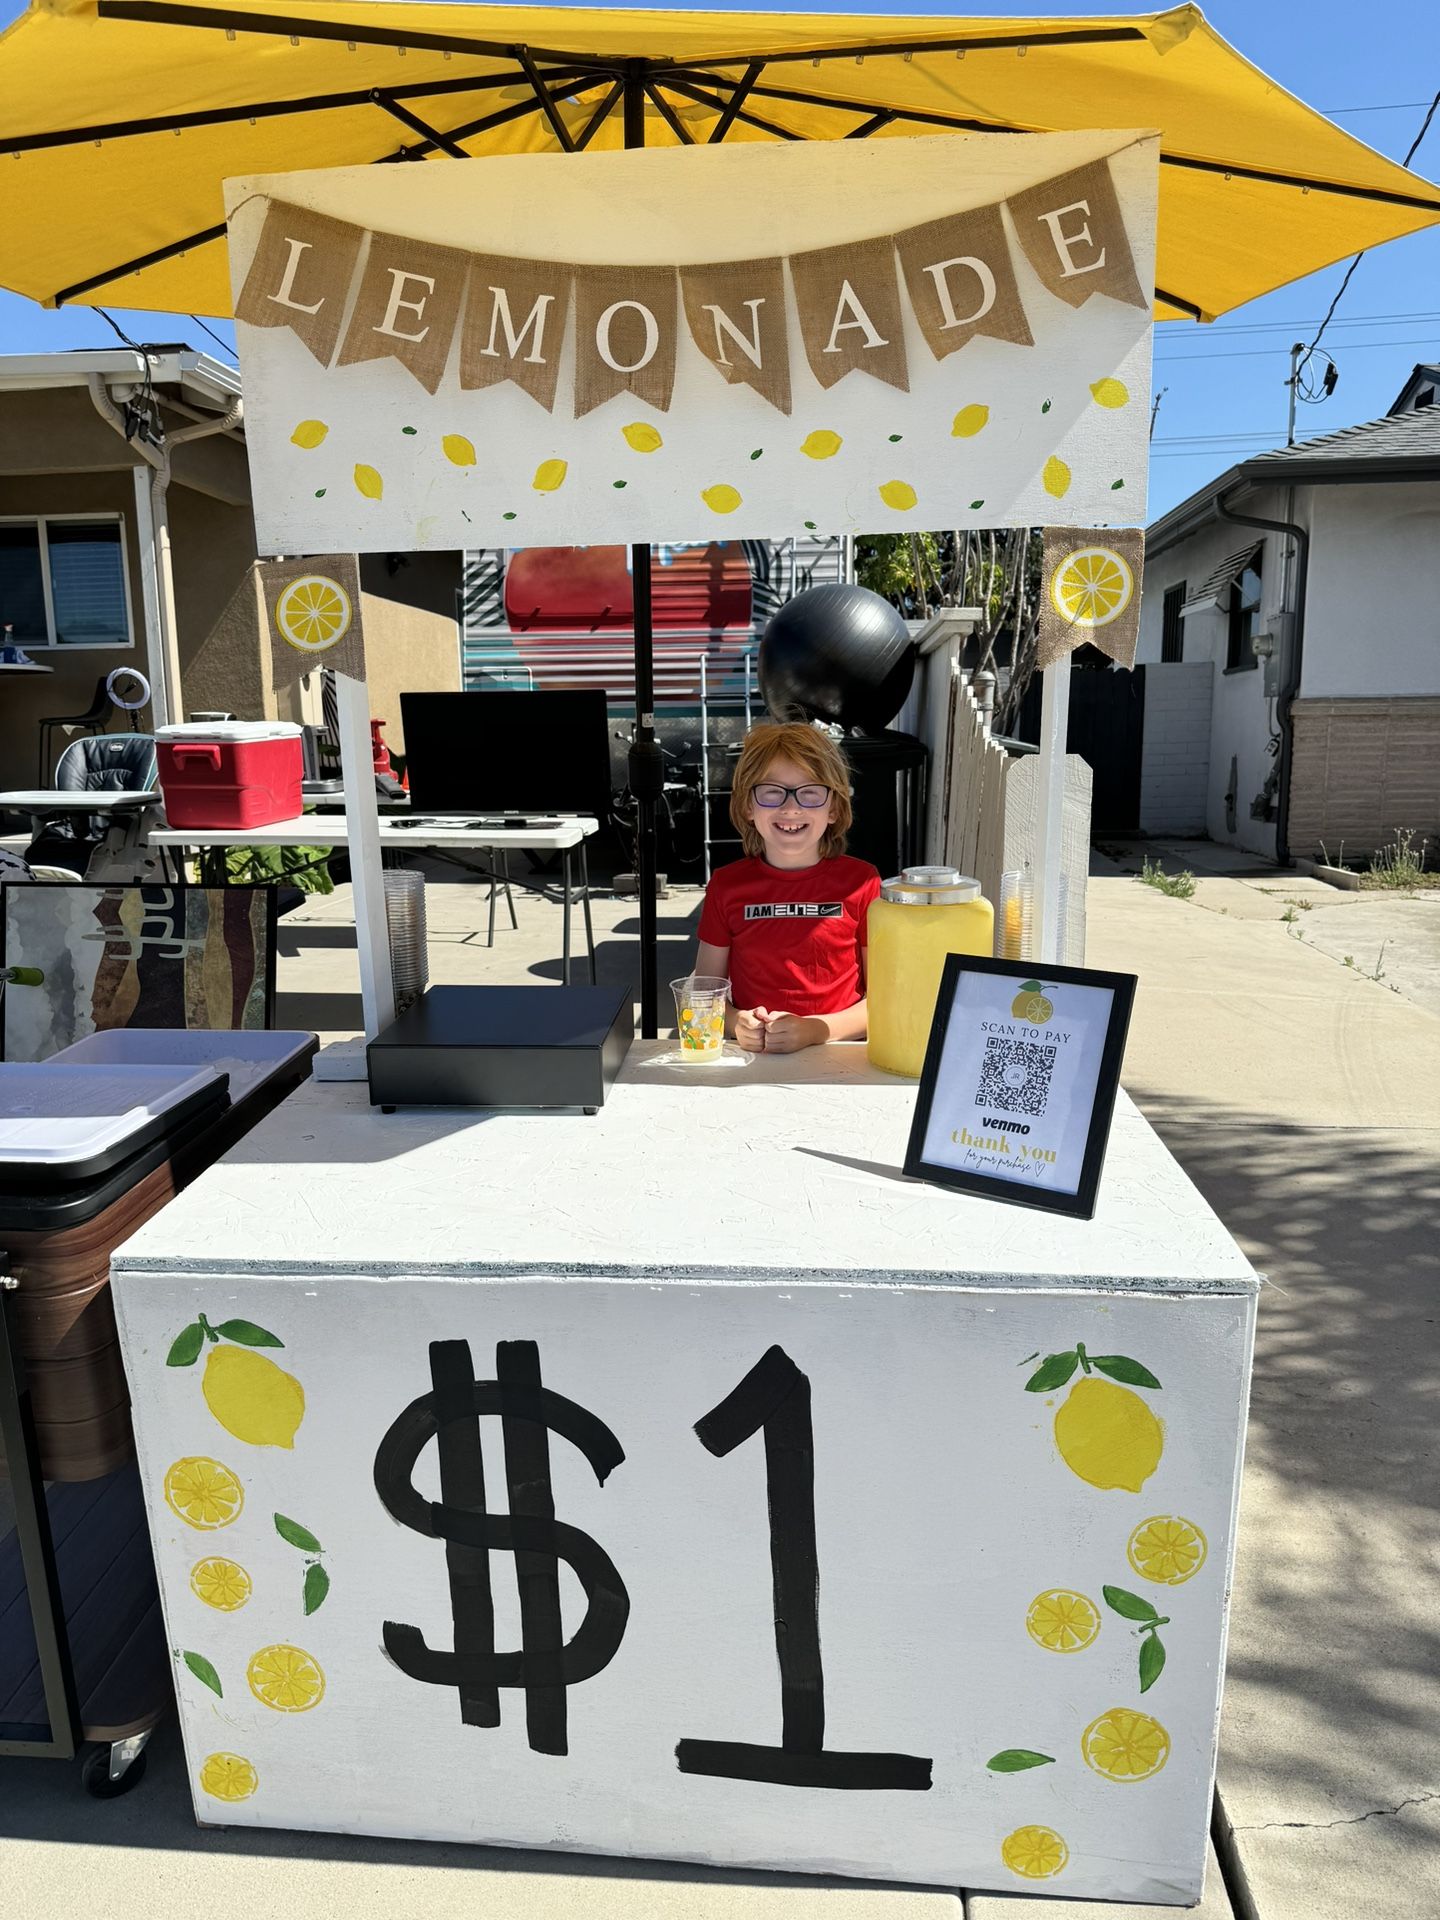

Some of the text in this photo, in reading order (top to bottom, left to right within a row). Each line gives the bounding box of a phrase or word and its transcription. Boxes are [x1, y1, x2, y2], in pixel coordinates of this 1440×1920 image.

[267, 200, 1106, 372] LEMONADE
[746, 904, 819, 918] I AM ELITE
[980, 1021, 1071, 1044] SCAN TO PAY
[982, 1117, 1031, 1135] venmo
[951, 1128, 1057, 1163] thank you
[963, 1148, 1031, 1173] for your purchase
[374, 1339, 933, 1791] $1
